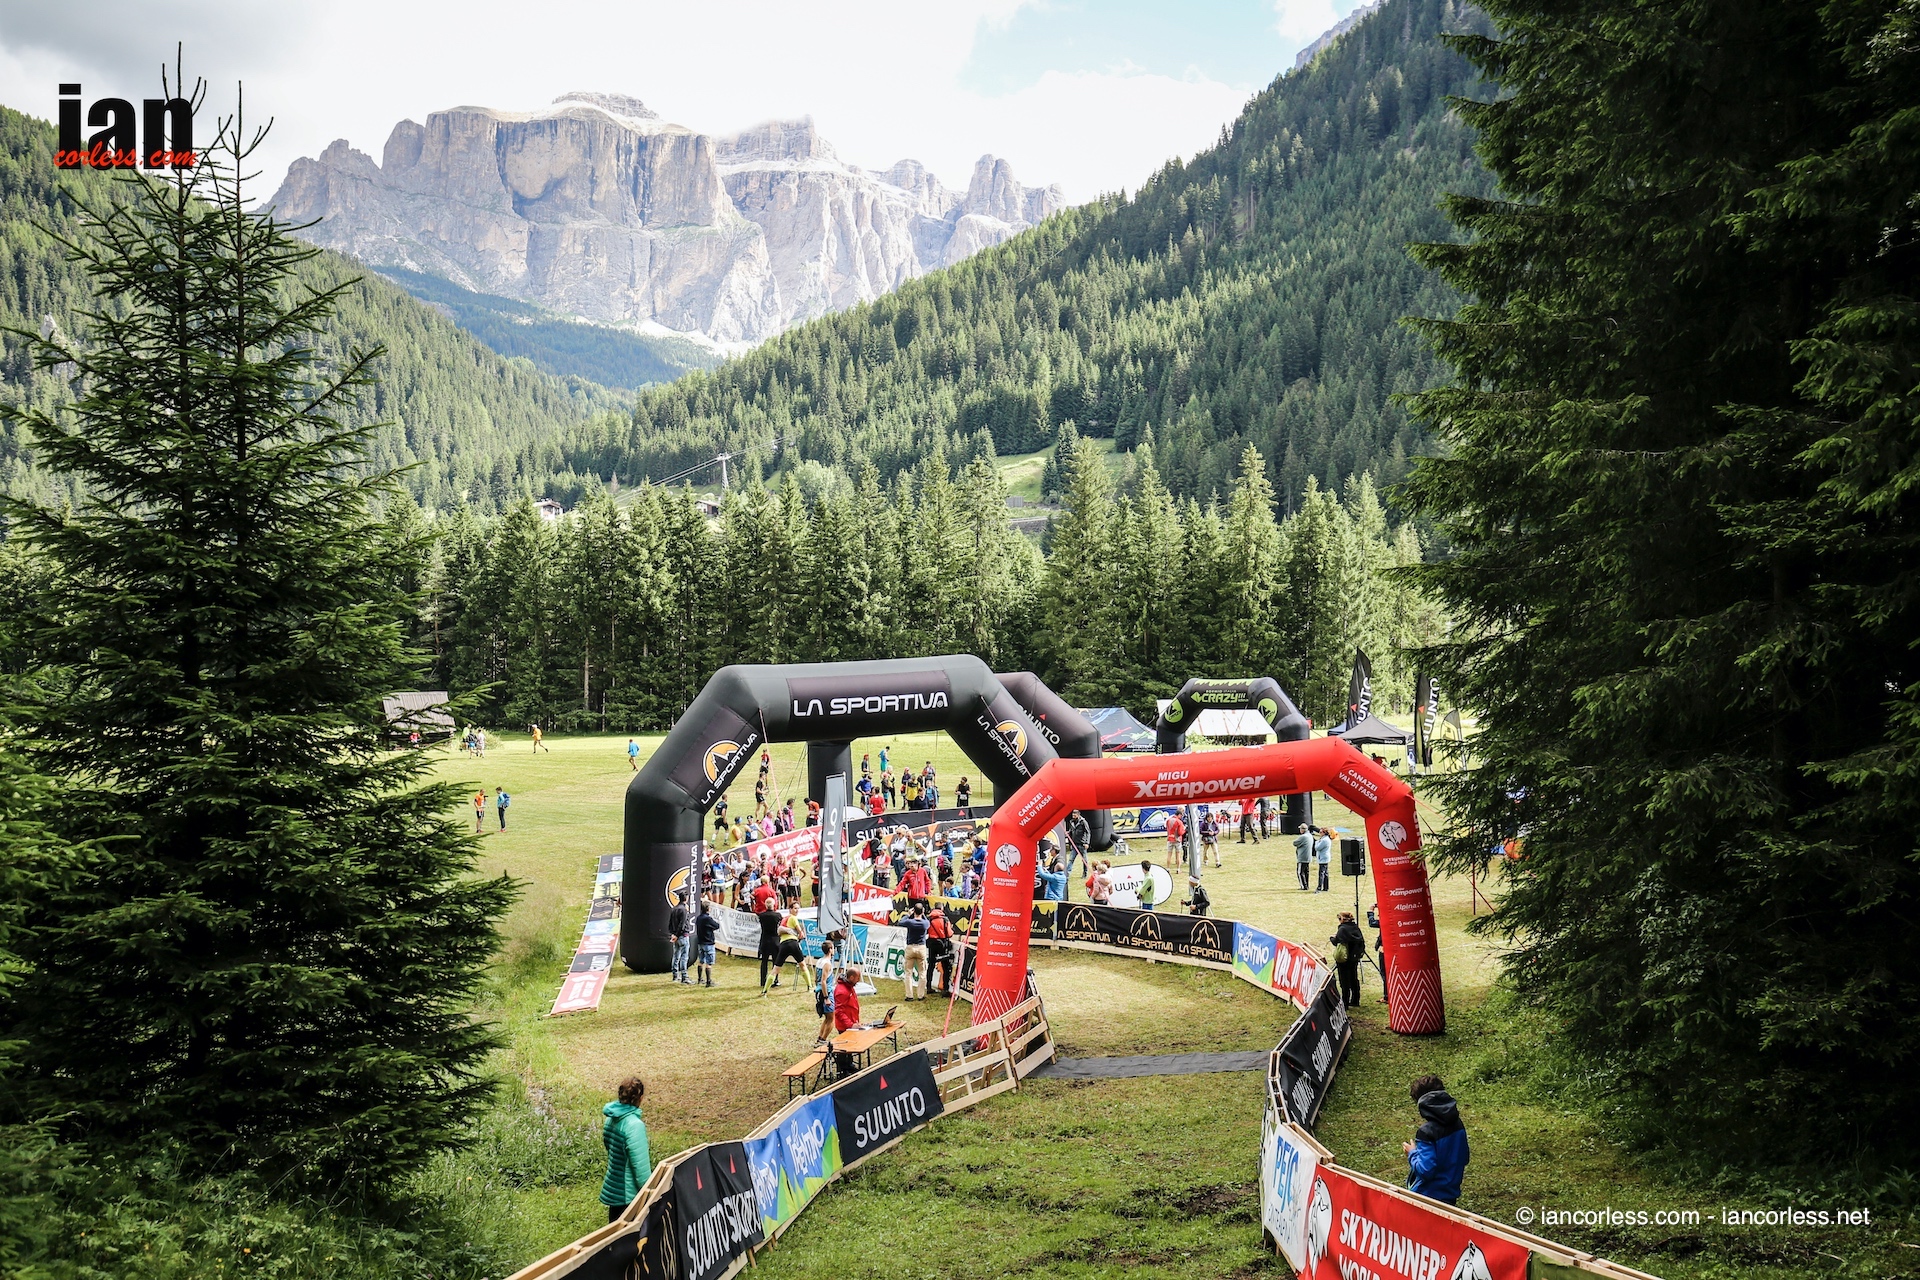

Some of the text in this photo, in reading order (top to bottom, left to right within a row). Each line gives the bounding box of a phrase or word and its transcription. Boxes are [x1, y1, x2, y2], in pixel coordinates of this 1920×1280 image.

[793, 691, 949, 717] LA SPORTIVA
[1201, 693, 1239, 703] CRAZY
[976, 714, 1028, 776] LA SPORTIVA
[701, 733, 758, 804] LA SPORTIVA
[1157, 770, 1190, 781] MIGU
[1347, 769, 1379, 792] CANAZEI
[1338, 772, 1378, 803] VAL DI FASSA
[1017, 792, 1044, 817] CANAZEI
[1018, 794, 1054, 827] VAL DI FASSA
[690, 844, 698, 914] SPORTIVA
[1065, 930, 1111, 942] SPORTIVA
[1116, 934, 1174, 952] LA SPORTIVA
[1178, 943, 1233, 963] LA SPORTIVA
[854, 1086, 926, 1148] SUUNTO
[686, 1200, 730, 1280] SUUNTO
